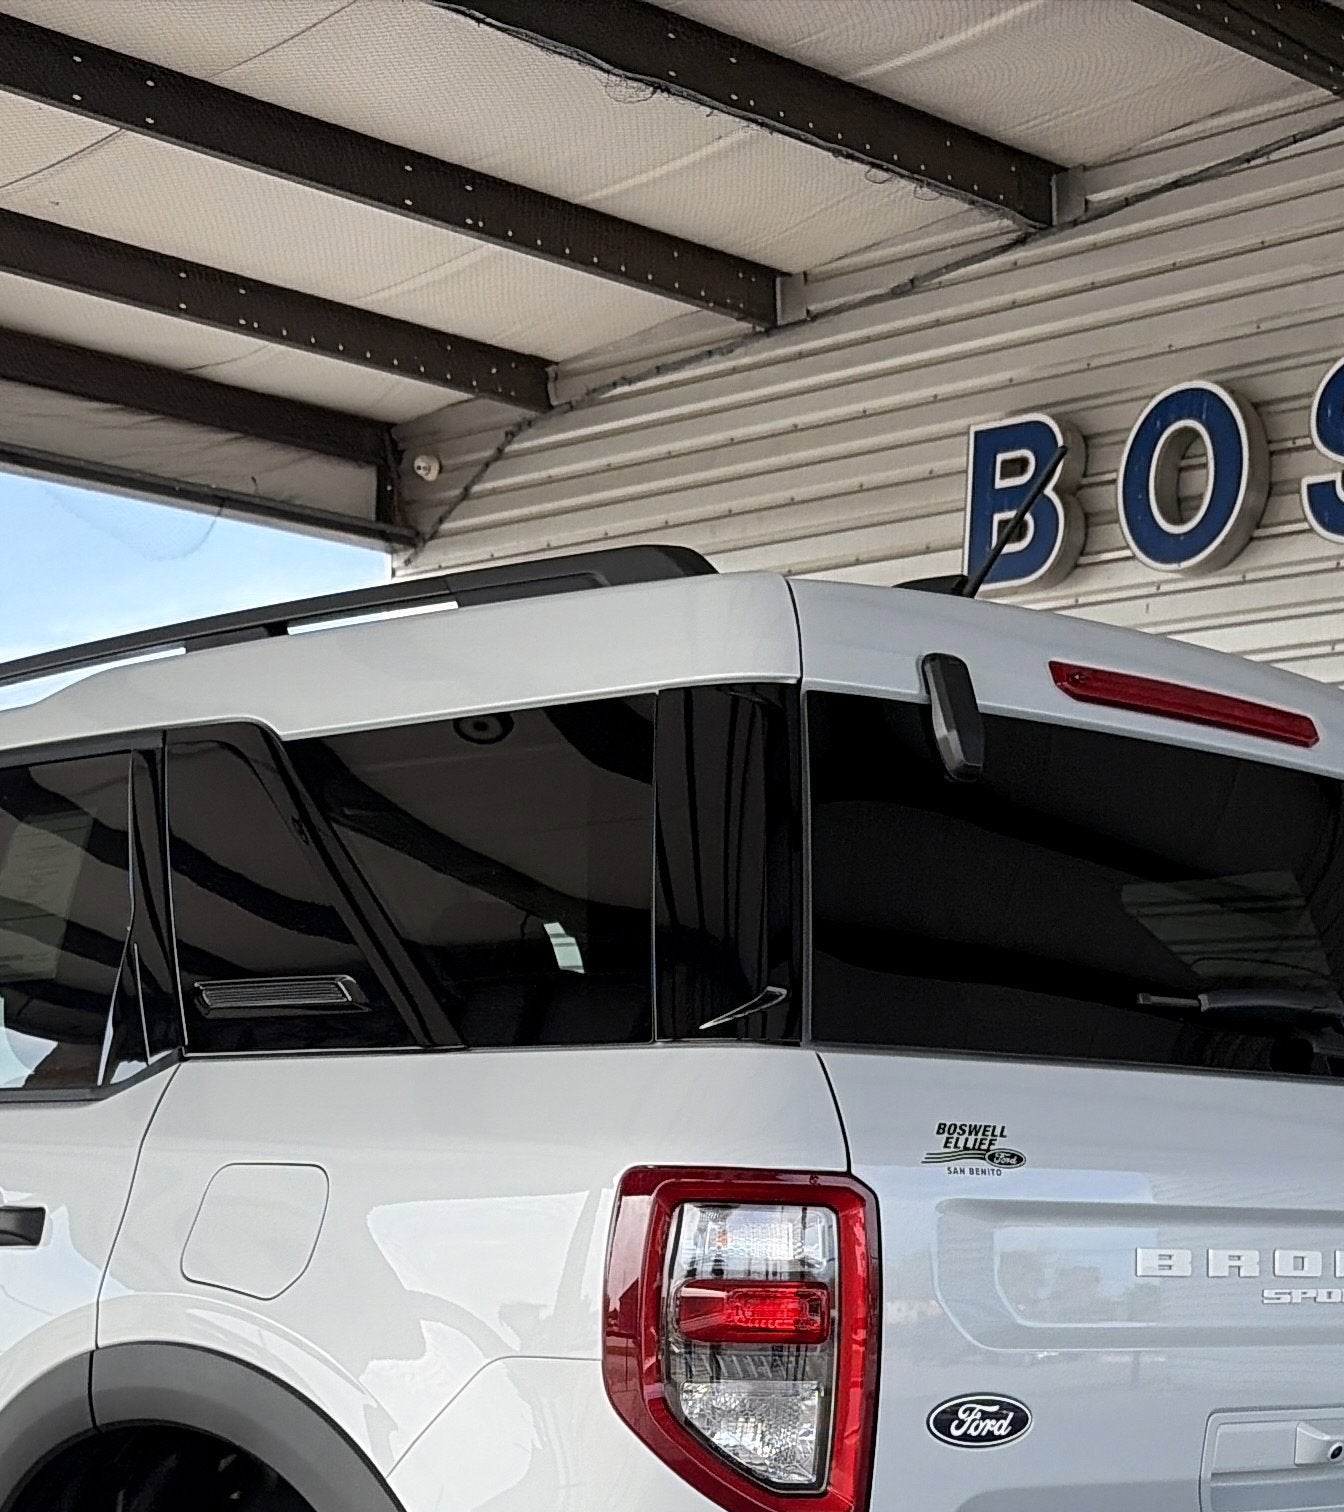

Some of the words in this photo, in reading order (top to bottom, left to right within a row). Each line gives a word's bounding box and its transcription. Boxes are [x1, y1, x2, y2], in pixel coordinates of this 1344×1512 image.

[935, 1122, 1008, 1138] BOSWELL
[943, 1136, 998, 1152] ELLIFF
[993, 1152, 1018, 1165] Ford
[947, 1166, 966, 1175] SAN
[968, 1168, 1003, 1177] BENITO
[949, 1403, 1015, 1437] Ford
